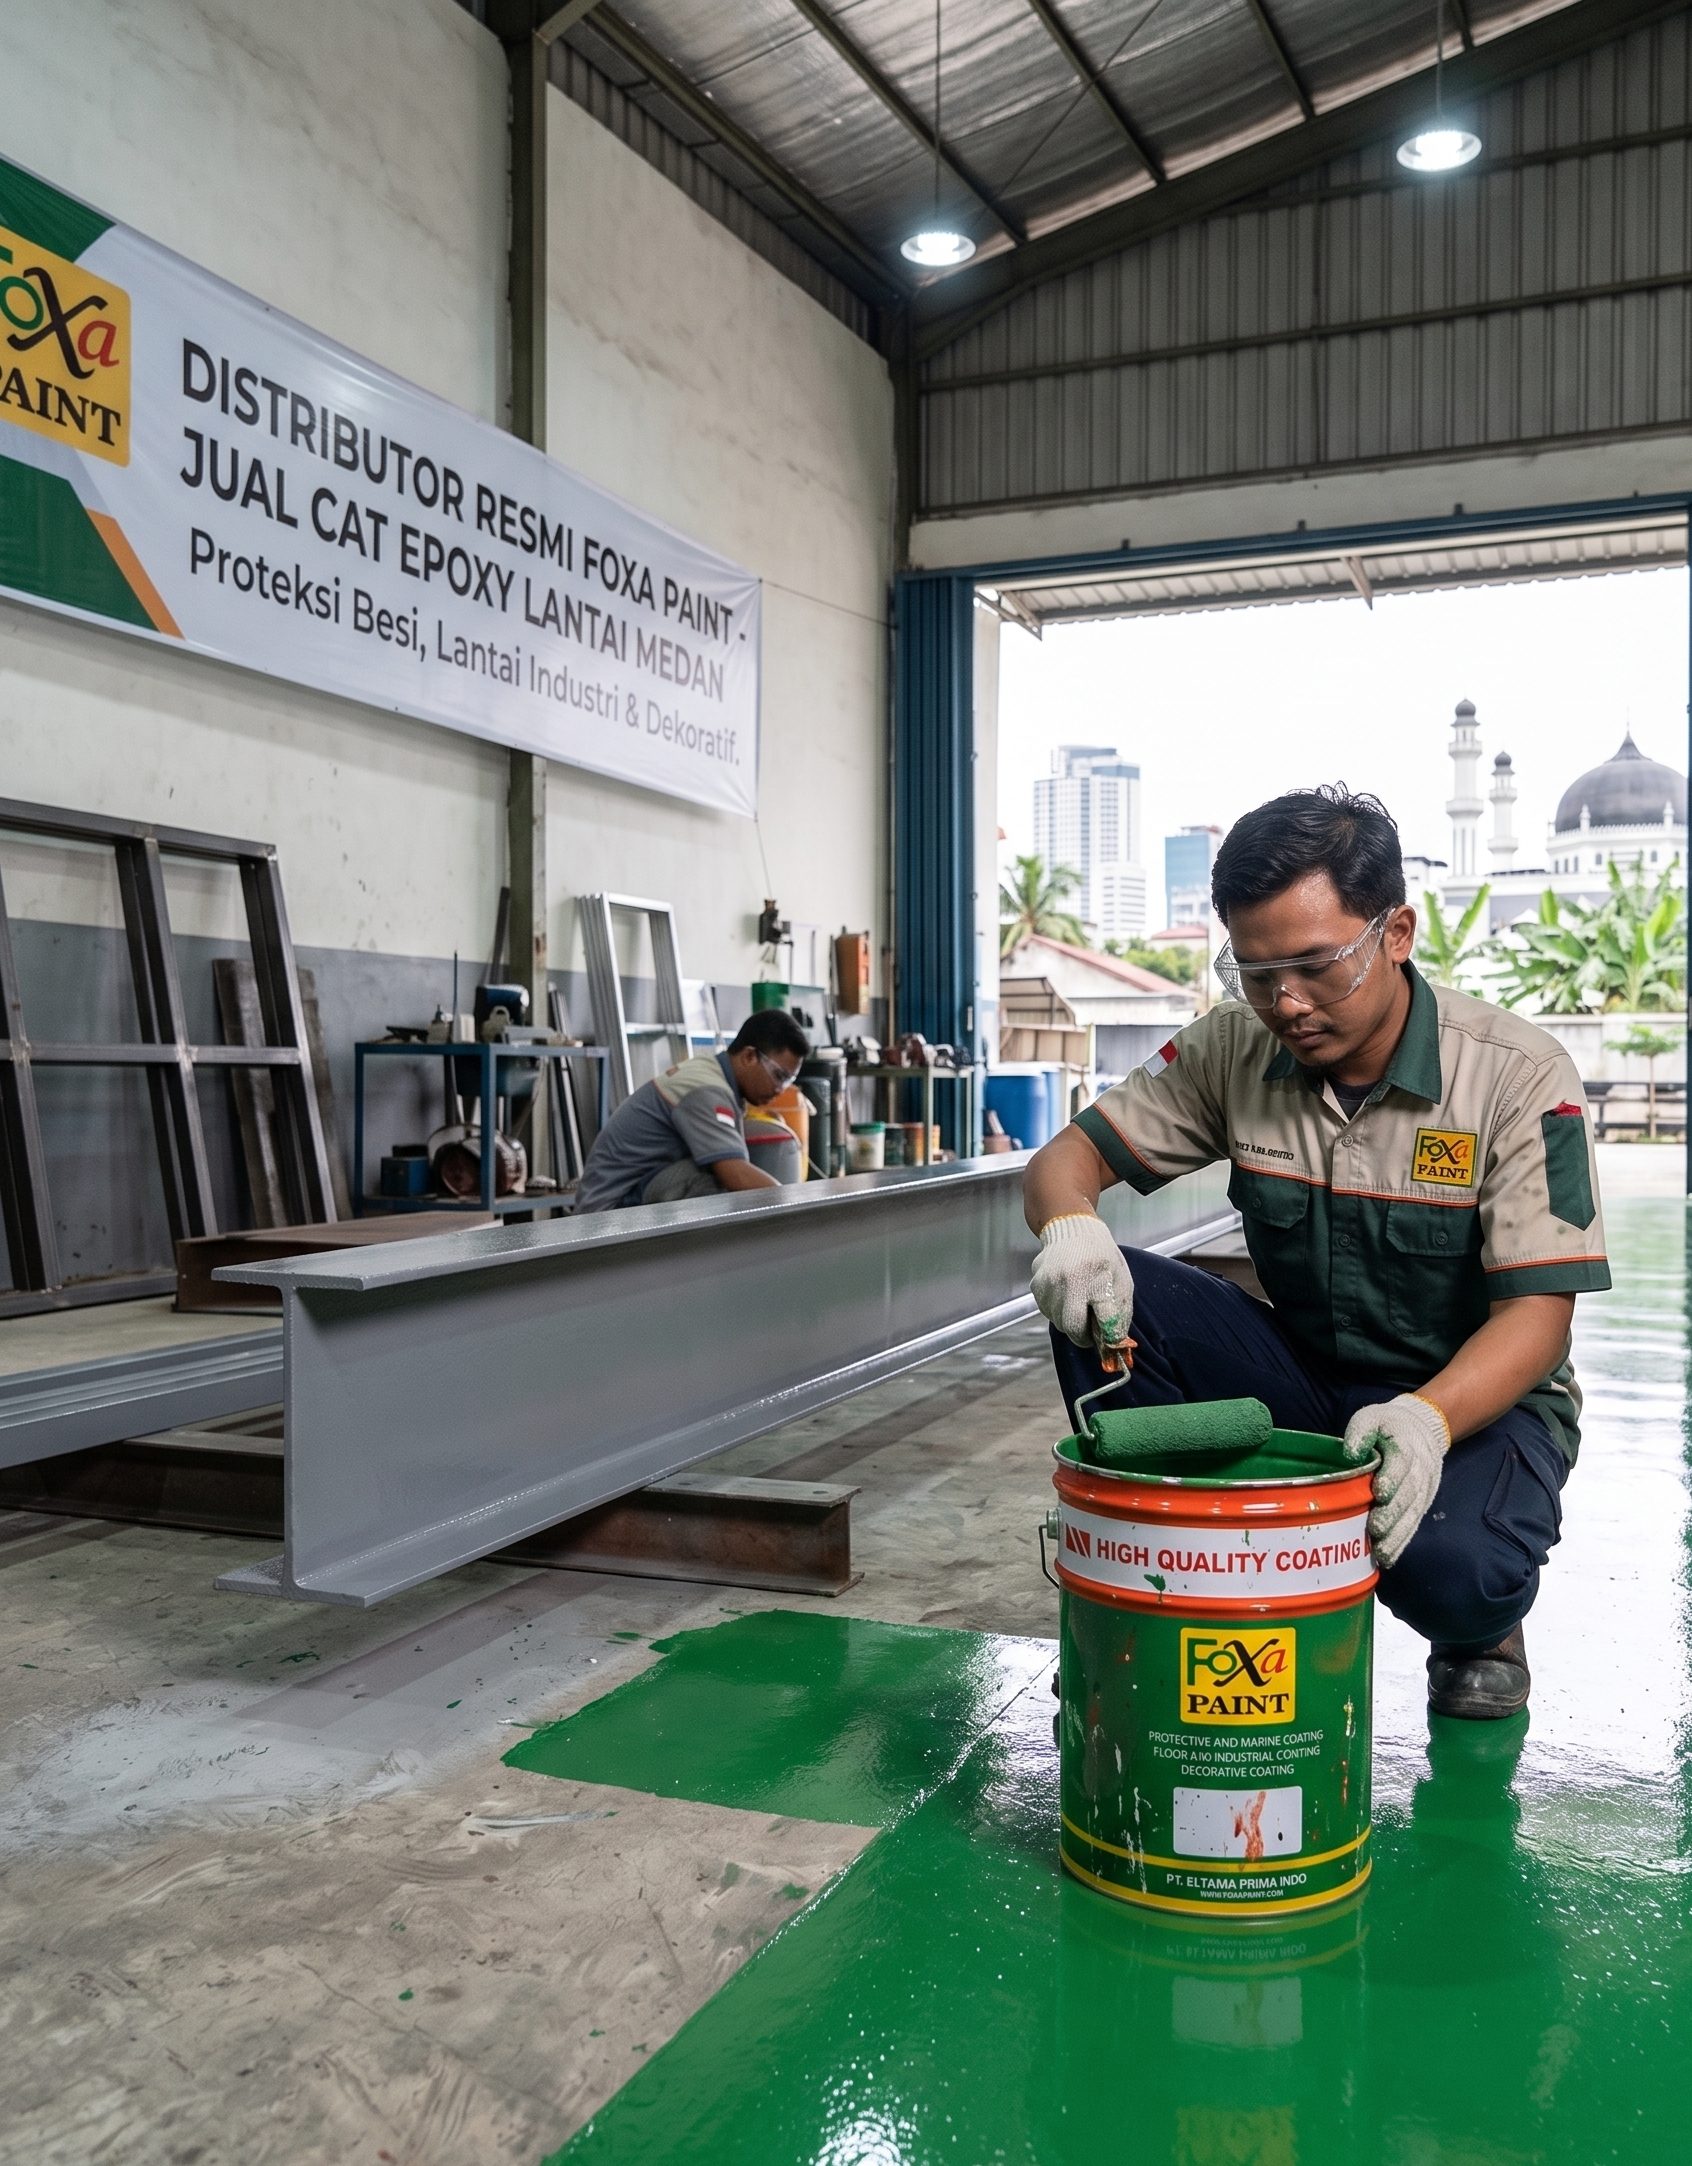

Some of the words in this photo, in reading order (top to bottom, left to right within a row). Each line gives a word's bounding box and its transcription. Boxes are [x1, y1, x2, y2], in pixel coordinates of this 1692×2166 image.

[0, 245, 119, 379] oXa
[0, 365, 121, 446] AINT
[183, 338, 464, 522] DISTRIBUTOR
[477, 483, 573, 572] RESMI
[584, 536, 655, 611] FOXA
[180, 426, 298, 529] JUAL
[311, 487, 388, 563] CAT
[401, 522, 515, 613] EPOXY
[525, 577, 627, 663] LANTAI
[637, 627, 724, 703] MEDAN
[191, 527, 340, 624] Proteksi
[354, 588, 426, 662] Besi,
[438, 619, 520, 687] Lantai
[530, 655, 619, 722] Industri
[625, 693, 640, 729] &
[646, 700, 740, 766] Dekoratif.
[1096, 1538, 1149, 1567] HIGH
[1157, 1549, 1270, 1573] QUALITY
[1275, 1538, 1361, 1571] COATING
[1187, 1692, 1290, 1715] PAINT
[1149, 1731, 1211, 1747] PROTECTIVE
[1213, 1737, 1239, 1748] AND
[1240, 1735, 1282, 1747] MARINE
[1282, 1729, 1324, 1745] COATING
[1153, 1746, 1188, 1760] FLOOR
[1214, 1752, 1274, 1762] INDUSTRIAL
[1181, 1764, 1247, 1777] DECORATIVE
[1249, 1763, 1295, 1777] COATING
[1166, 1873, 1184, 1886] PT.
[1186, 1876, 1237, 1889] ELTAMA
[1239, 1877, 1278, 1889] PRIMA
[1279, 1873, 1307, 1887] INDO
